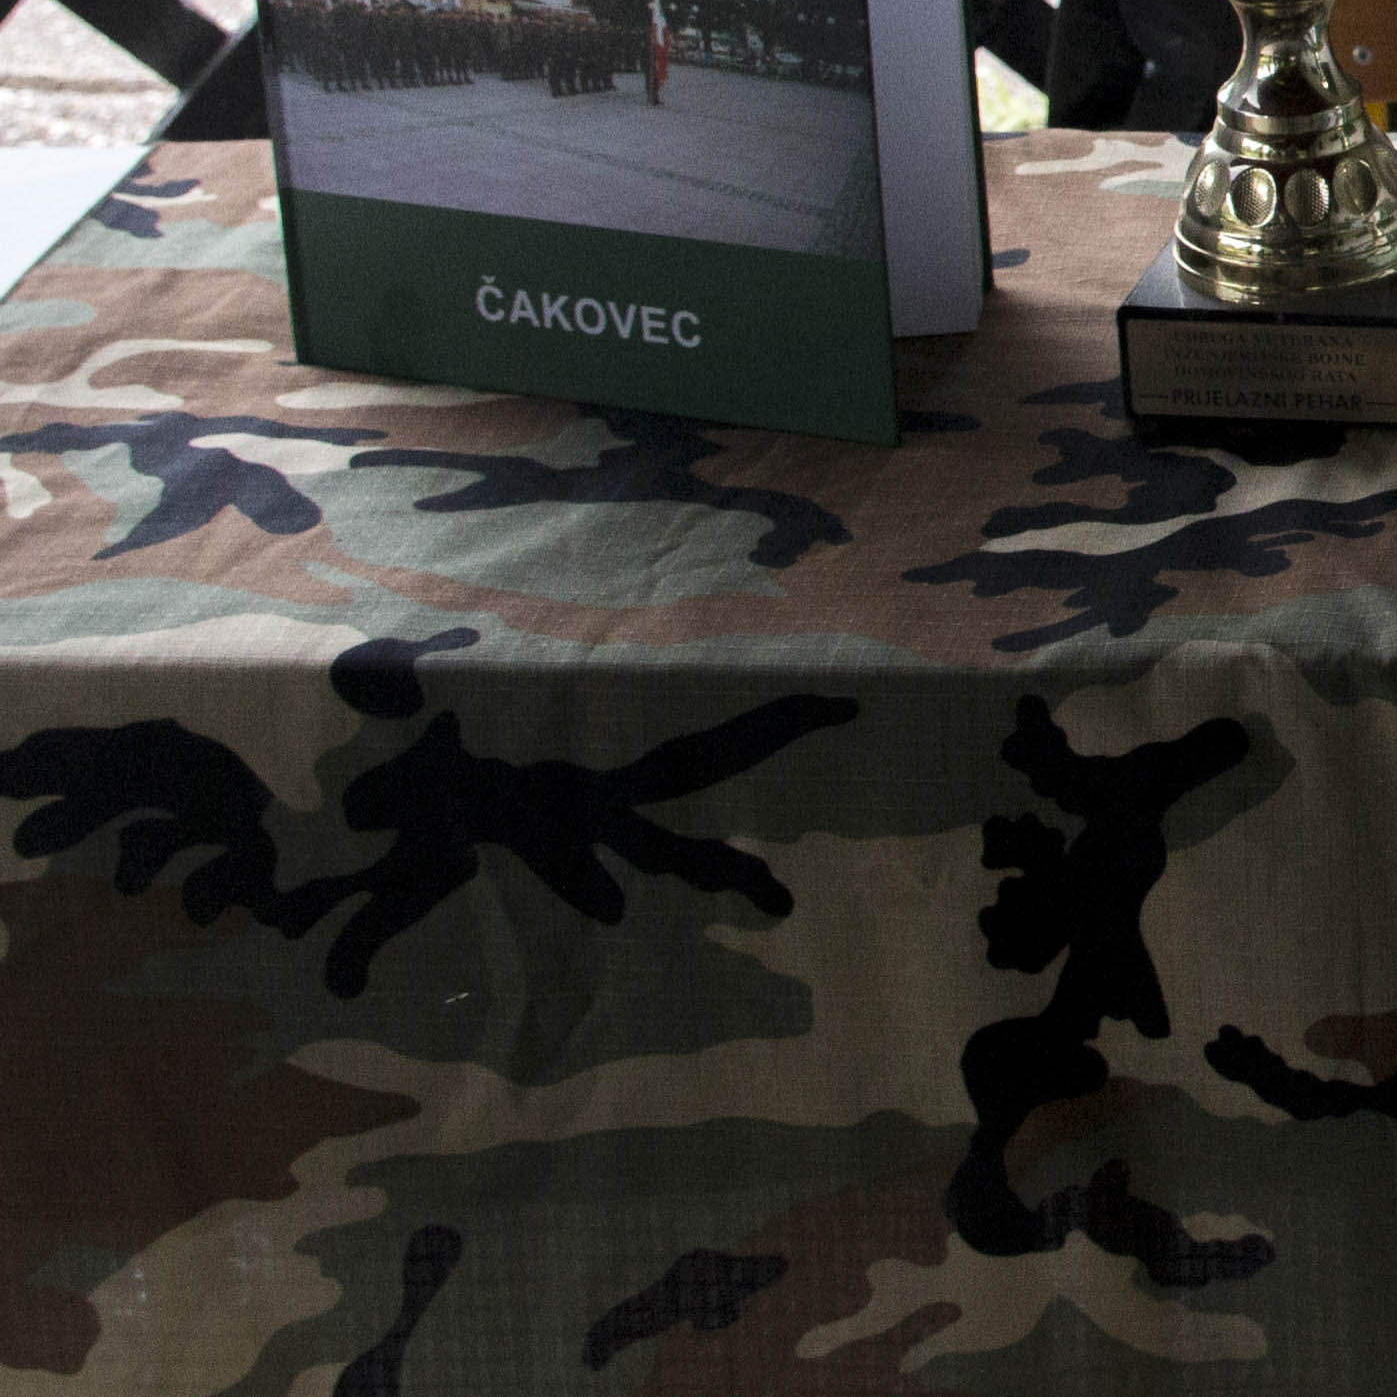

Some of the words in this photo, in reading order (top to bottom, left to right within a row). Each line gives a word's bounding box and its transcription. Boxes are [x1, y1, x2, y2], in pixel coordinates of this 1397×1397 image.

[476, 274, 701, 348] ČAKOVEC
[1171, 388, 1287, 409] PRIJELAZNI
[1294, 392, 1364, 411] PEHAR
